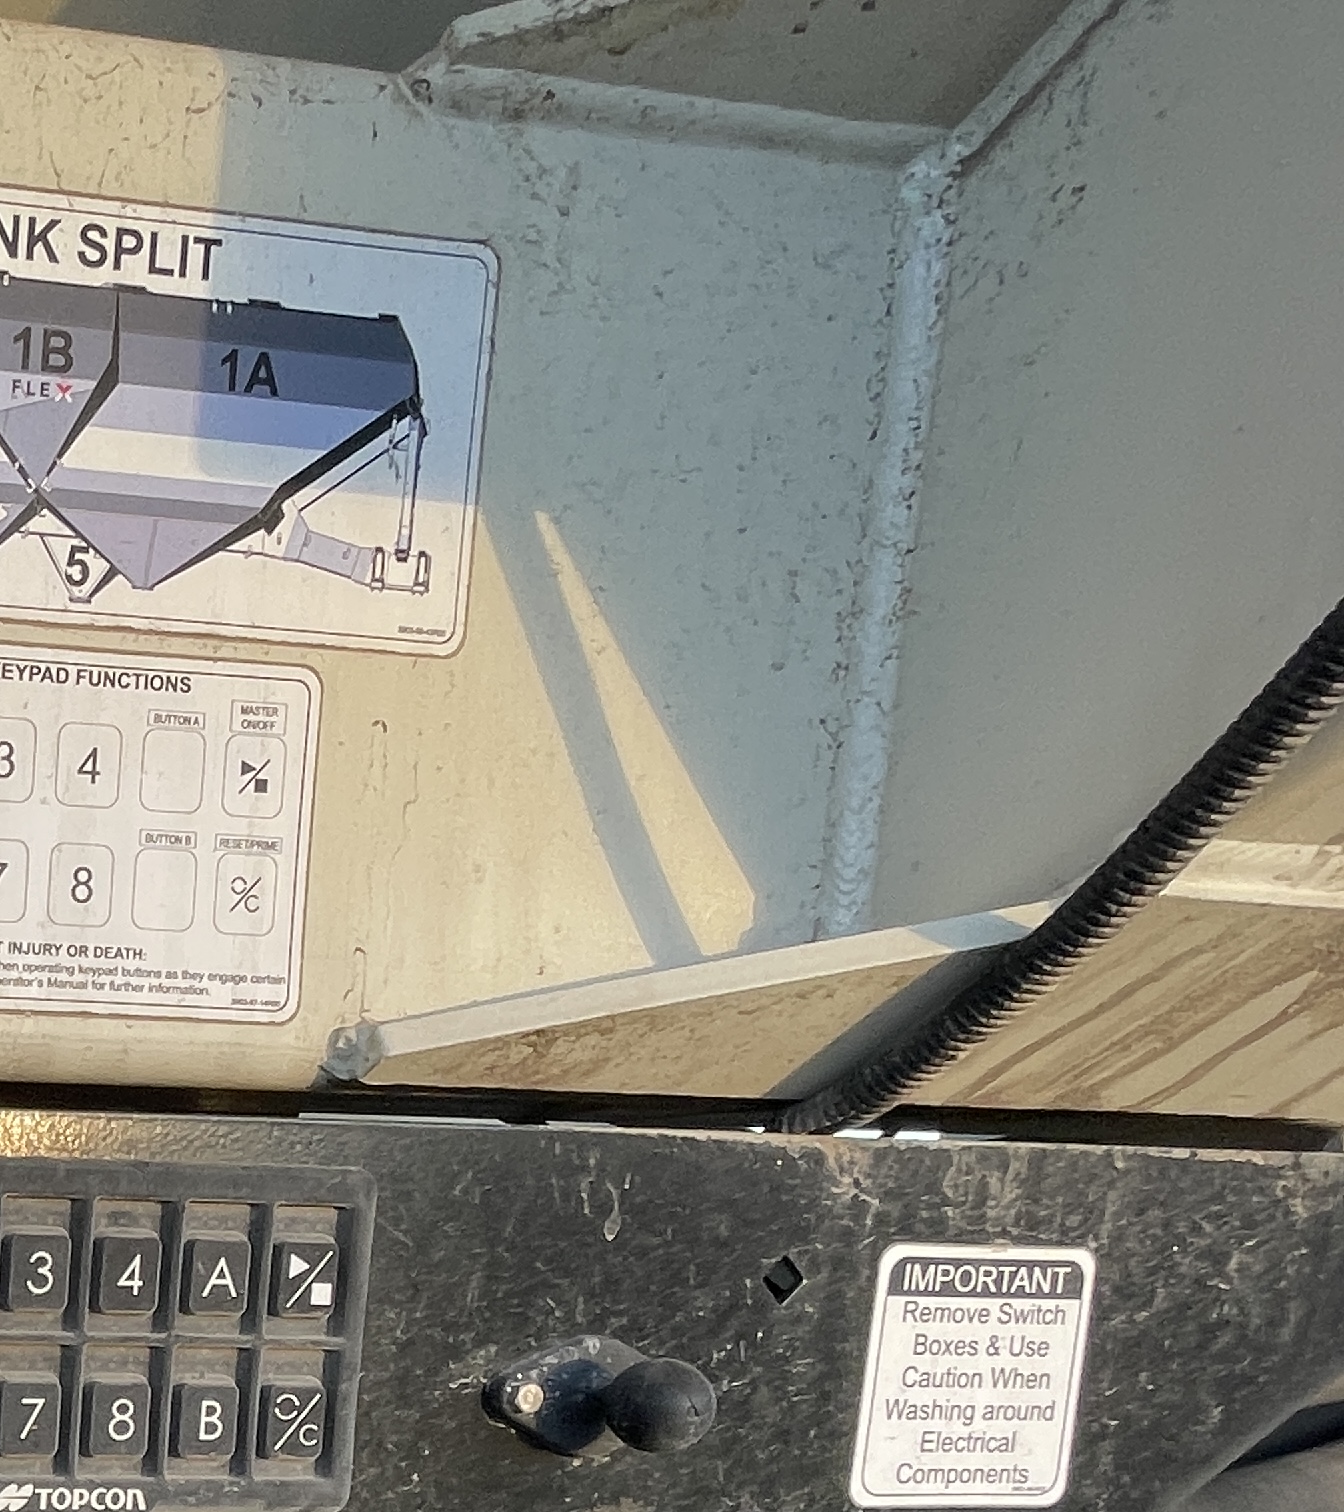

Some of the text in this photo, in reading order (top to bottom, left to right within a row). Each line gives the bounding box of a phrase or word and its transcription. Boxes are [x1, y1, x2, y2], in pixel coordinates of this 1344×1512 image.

[77, 223, 224, 282] SPLIT
[11, 326, 75, 375] 1B
[218, 348, 279, 398] 1A
[11, 378, 75, 403] FLEX
[64, 542, 91, 588] 5
[76, 667, 192, 694] FUNCTIONS
[192, 716, 200, 726] A
[77, 747, 101, 784] 4
[71, 867, 94, 904] 8
[8, 940, 63, 957] INJURY
[66, 944, 89, 959] OR
[93, 946, 148, 961] DEATH:
[25, 1251, 54, 1295] 3
[117, 1254, 144, 1297] 4
[201, 1256, 238, 1299] A
[902, 1263, 1071, 1294] IMPORTANT
[902, 1301, 1066, 1325] Remove Switch
[913, 1334, 1050, 1357] Boxes & Use
[902, 1366, 1051, 1389] Caution When
[20, 1398, 45, 1440] 7
[108, 1398, 135, 1441] 8
[199, 1401, 224, 1441] B
[884, 1398, 1056, 1426] Washing around
[920, 1431, 1017, 1453] Electrical
[896, 1463, 1029, 1489] Components
[34, 1486, 147, 1512] TOPCON
